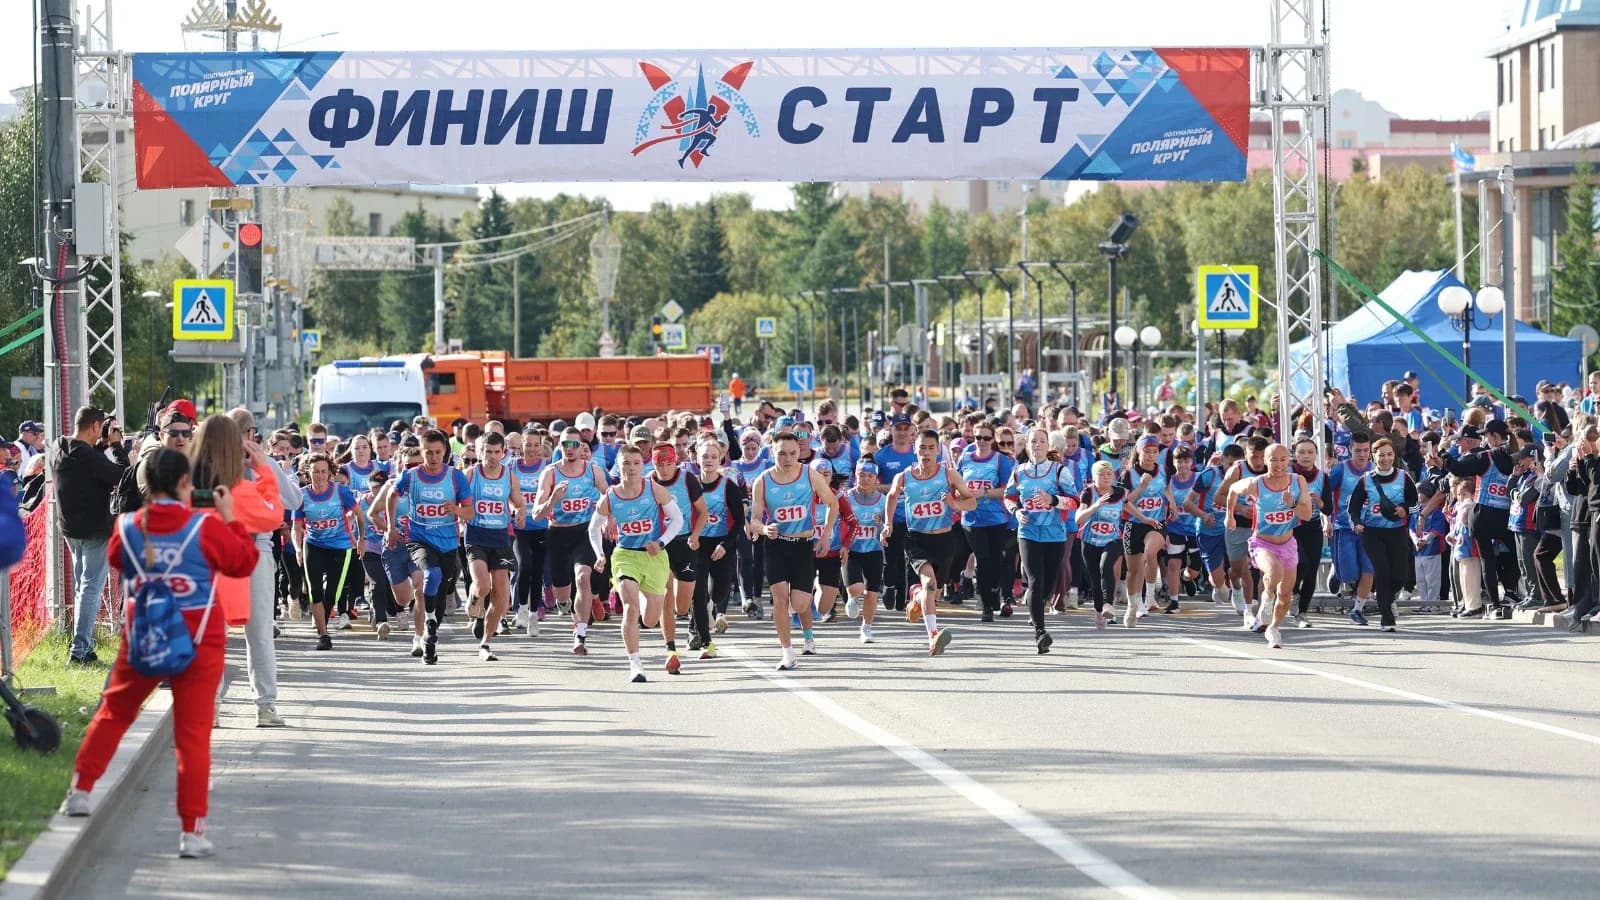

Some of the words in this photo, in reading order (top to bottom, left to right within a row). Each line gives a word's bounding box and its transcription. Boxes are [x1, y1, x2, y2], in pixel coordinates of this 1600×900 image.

[169, 71, 255, 98] ПОЛЯРНЫЙ
[193, 92, 231, 109] КРУГ
[308, 88, 613, 149] ФИНИШ
[777, 86, 1079, 151] СТАРТ
[1130, 130, 1214, 154] ПОЛЯРНЫЙ
[1152, 149, 1190, 165] КРУГ
[968, 480, 992, 490] 475
[416, 504, 447, 517] 460
[477, 501, 503, 514] 615
[562, 498, 589, 512] 385
[913, 501, 943, 517] 413
[1137, 498, 1161, 510] 494
[777, 506, 803, 521] 311
[1265, 510, 1294, 523] 498
[621, 519, 652, 534] 495
